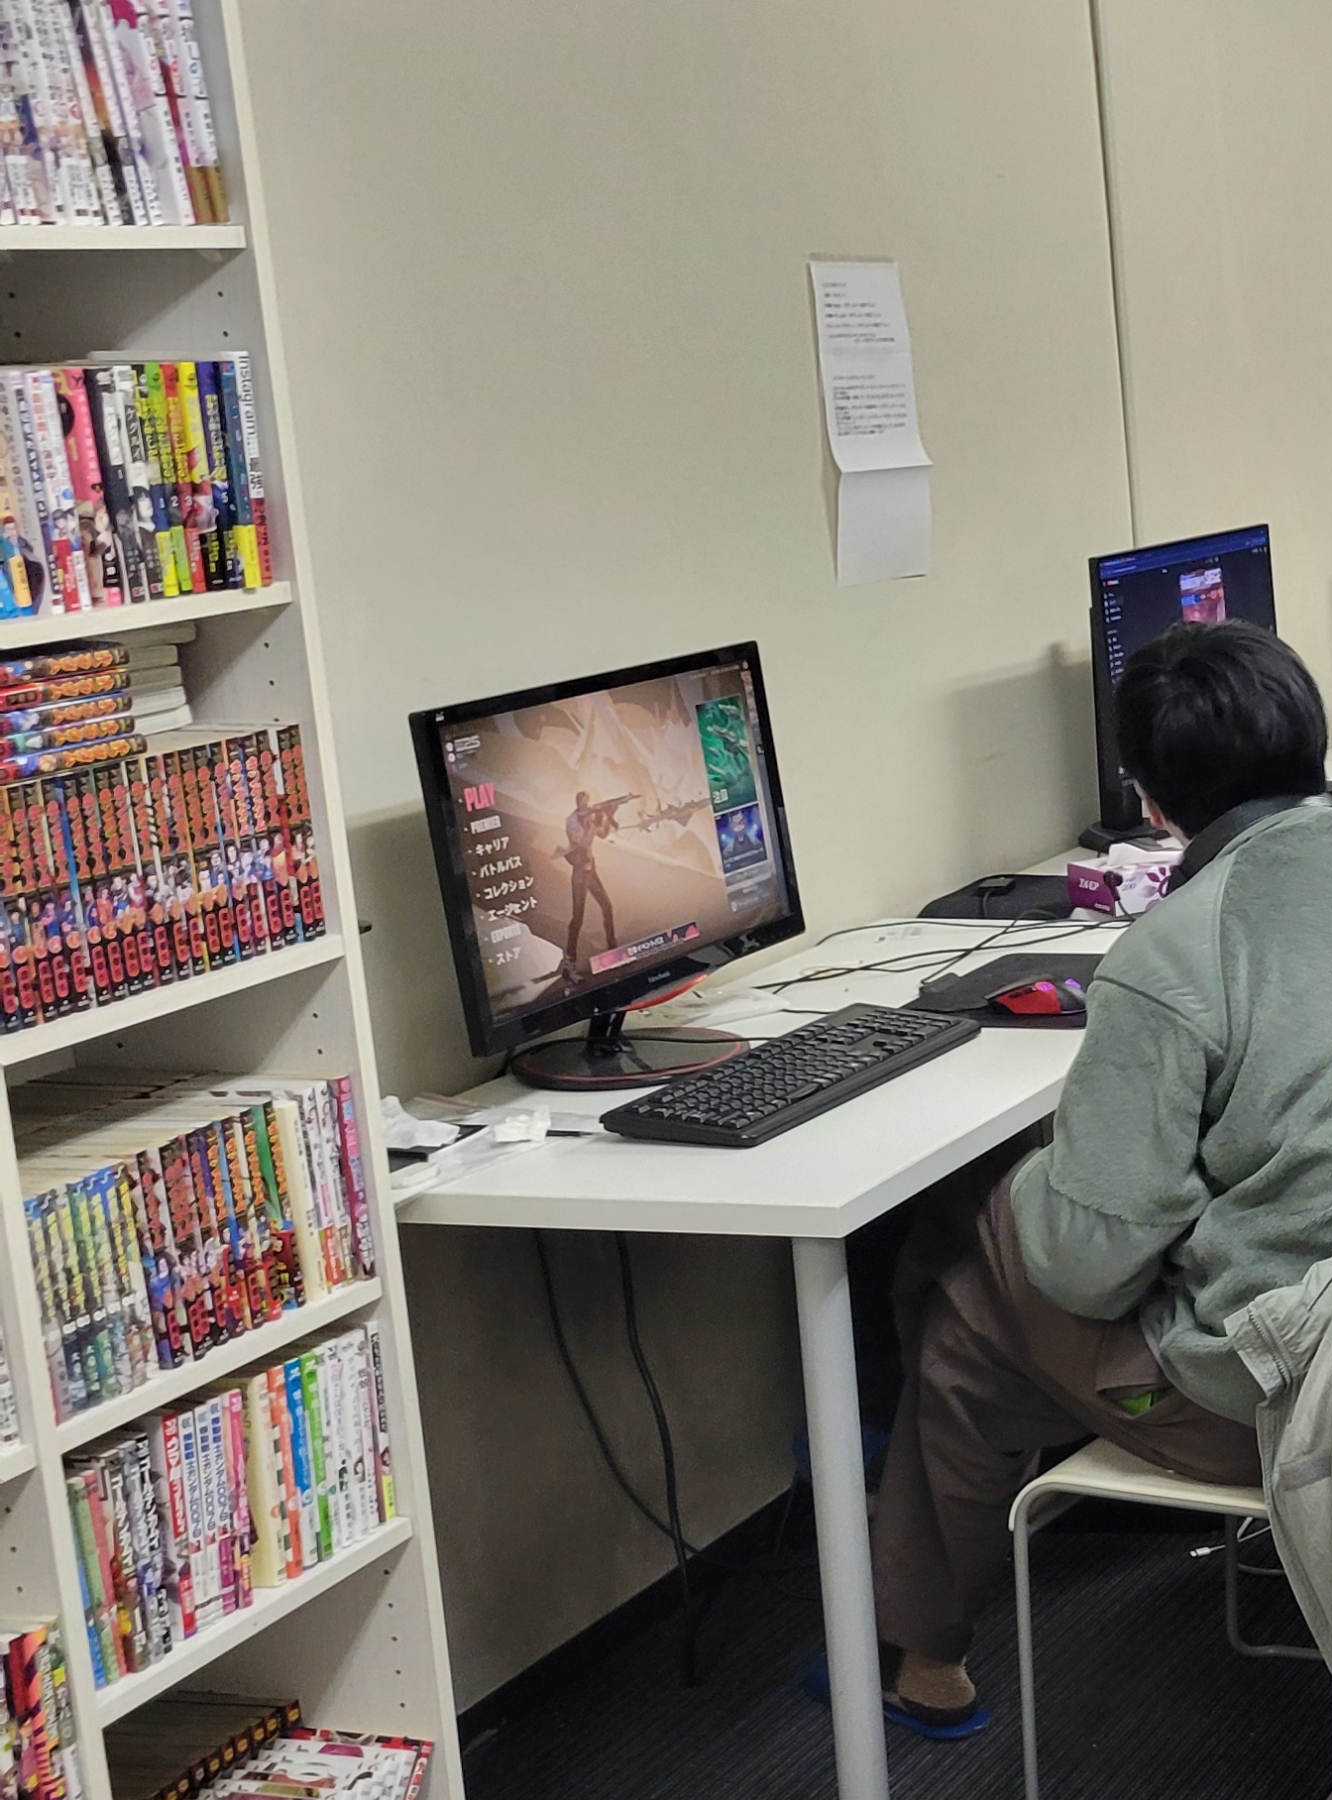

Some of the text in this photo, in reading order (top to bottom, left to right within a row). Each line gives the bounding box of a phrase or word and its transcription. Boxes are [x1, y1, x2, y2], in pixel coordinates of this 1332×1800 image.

[237, 355, 256, 436] Instagram
[170, 495, 179, 508] 2
[463, 782, 496, 812] PLAY
[475, 836, 510, 856] キャリア
[480, 856, 523, 878] バトルパス
[484, 875, 534, 899] コレクション
[488, 896, 538, 921] エージェント
[496, 947, 521, 965] ストア
